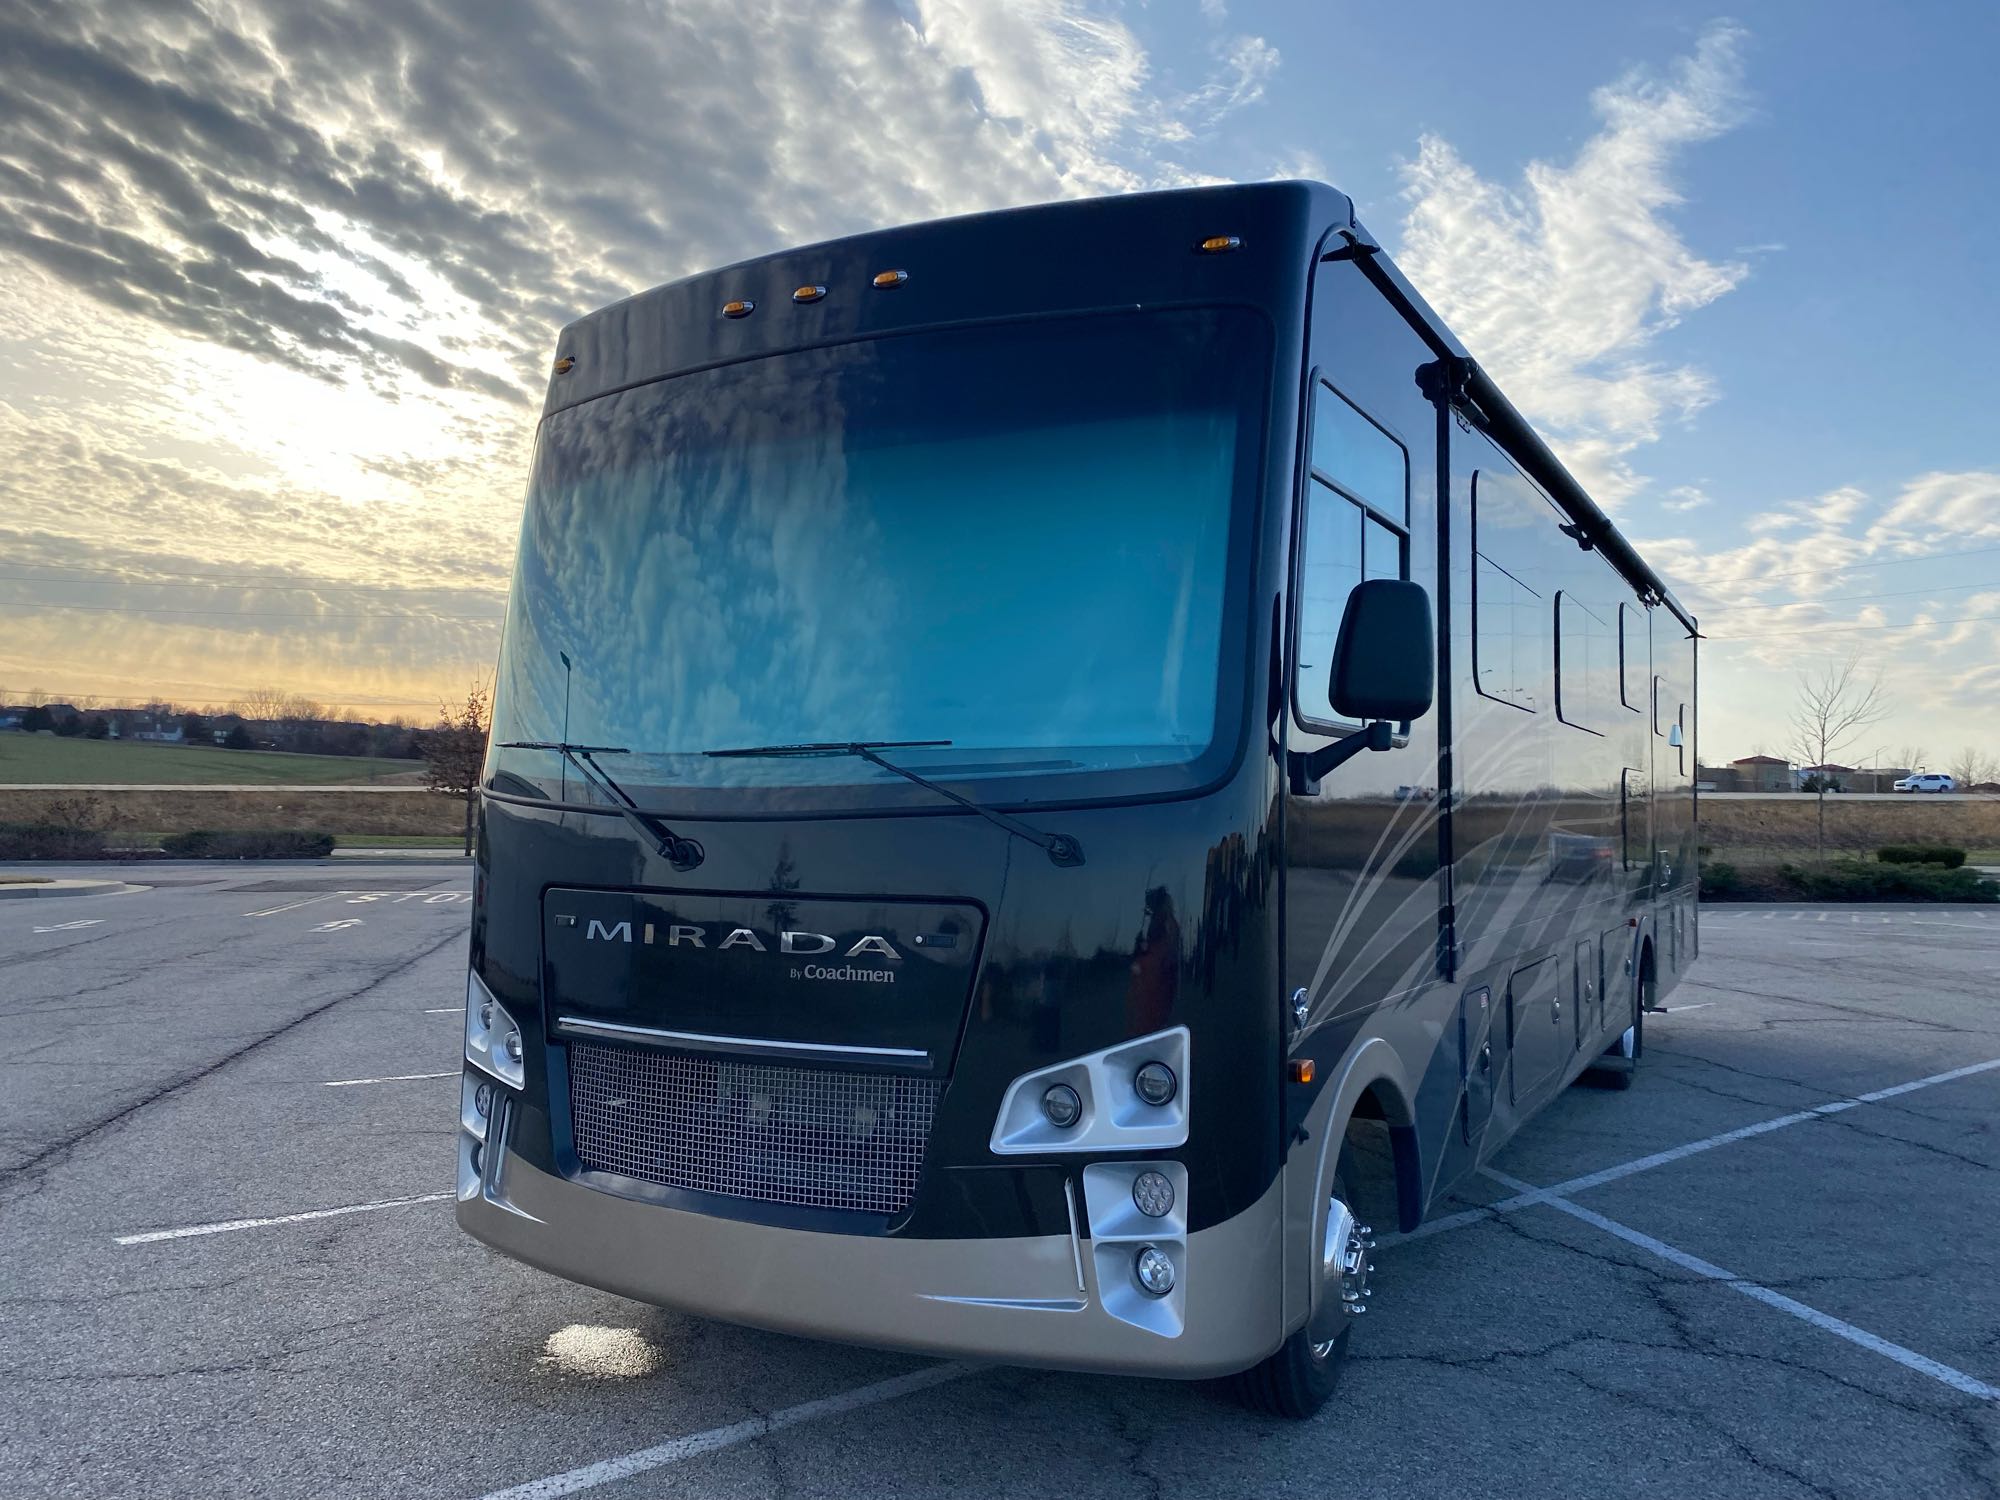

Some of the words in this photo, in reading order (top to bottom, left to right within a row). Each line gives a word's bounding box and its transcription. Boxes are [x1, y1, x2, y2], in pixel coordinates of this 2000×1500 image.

[586, 919, 902, 959] MIRADA
[790, 968, 803, 980] By
[804, 964, 895, 983] Coachmen
